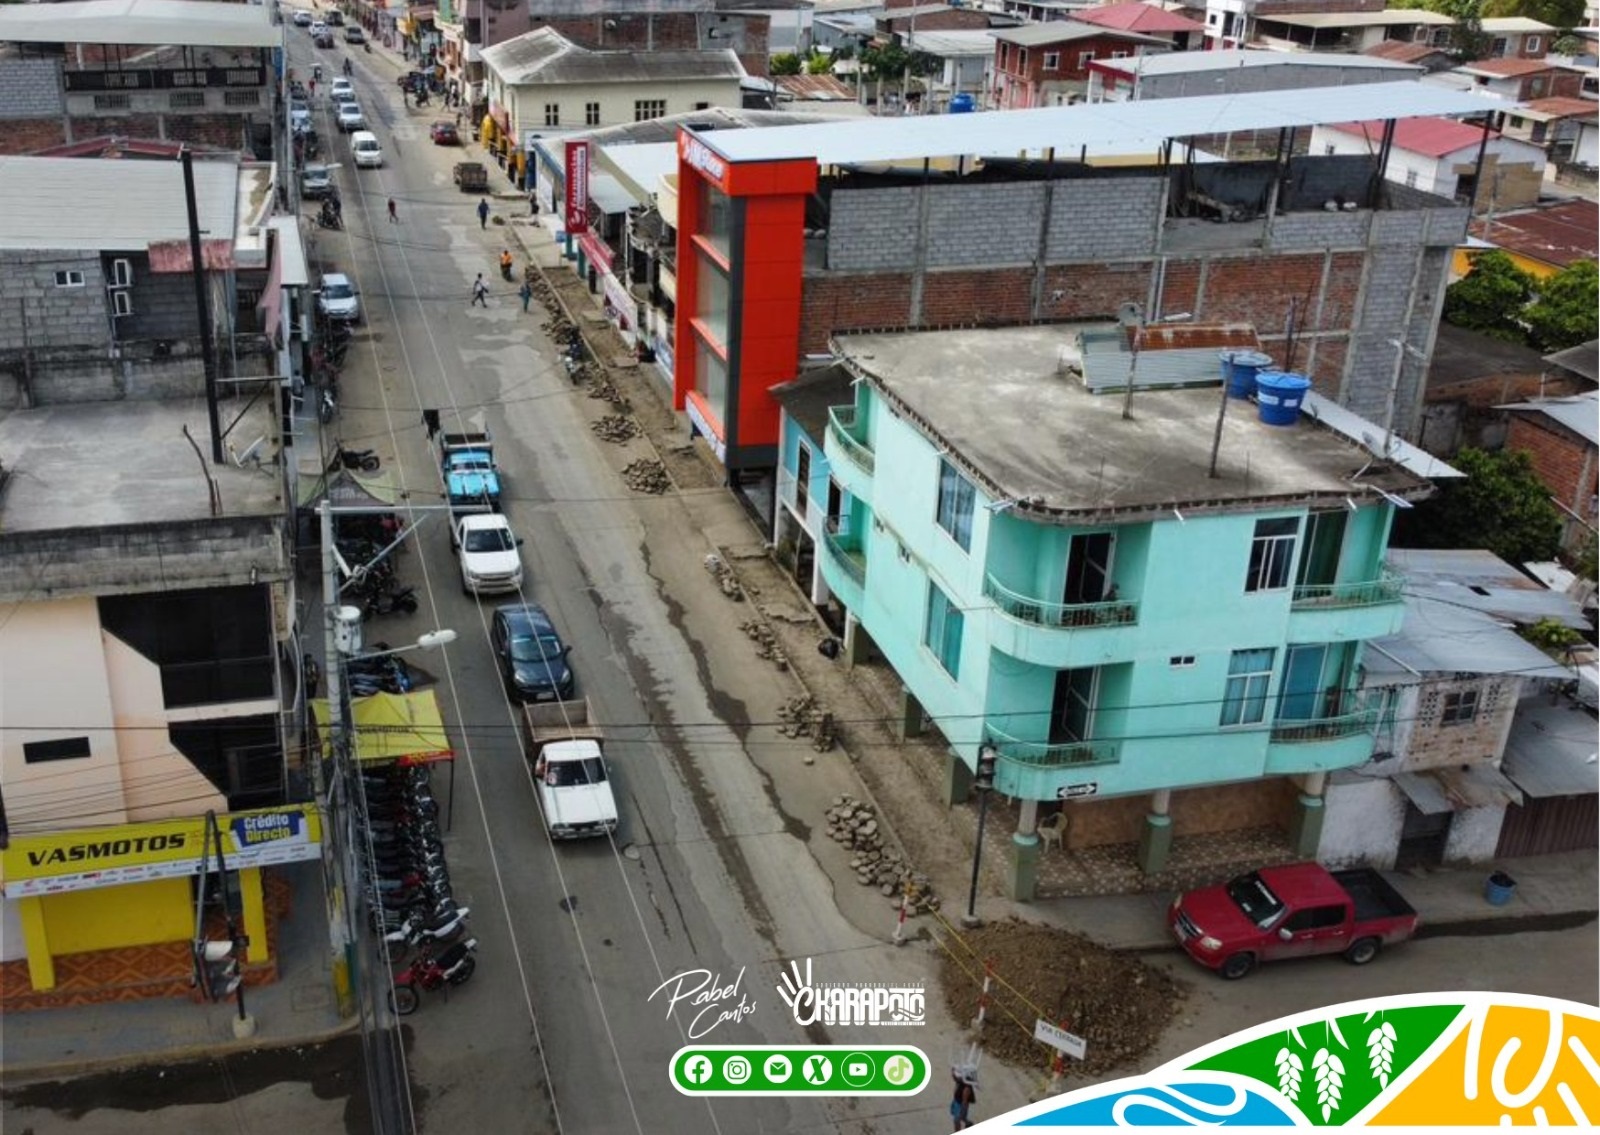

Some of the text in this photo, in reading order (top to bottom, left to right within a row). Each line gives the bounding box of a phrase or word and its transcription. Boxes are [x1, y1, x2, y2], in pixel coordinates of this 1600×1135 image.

[244, 814, 289, 830] Crédito
[245, 827, 291, 844] Directo
[28, 832, 186, 867] VASMOTOS
